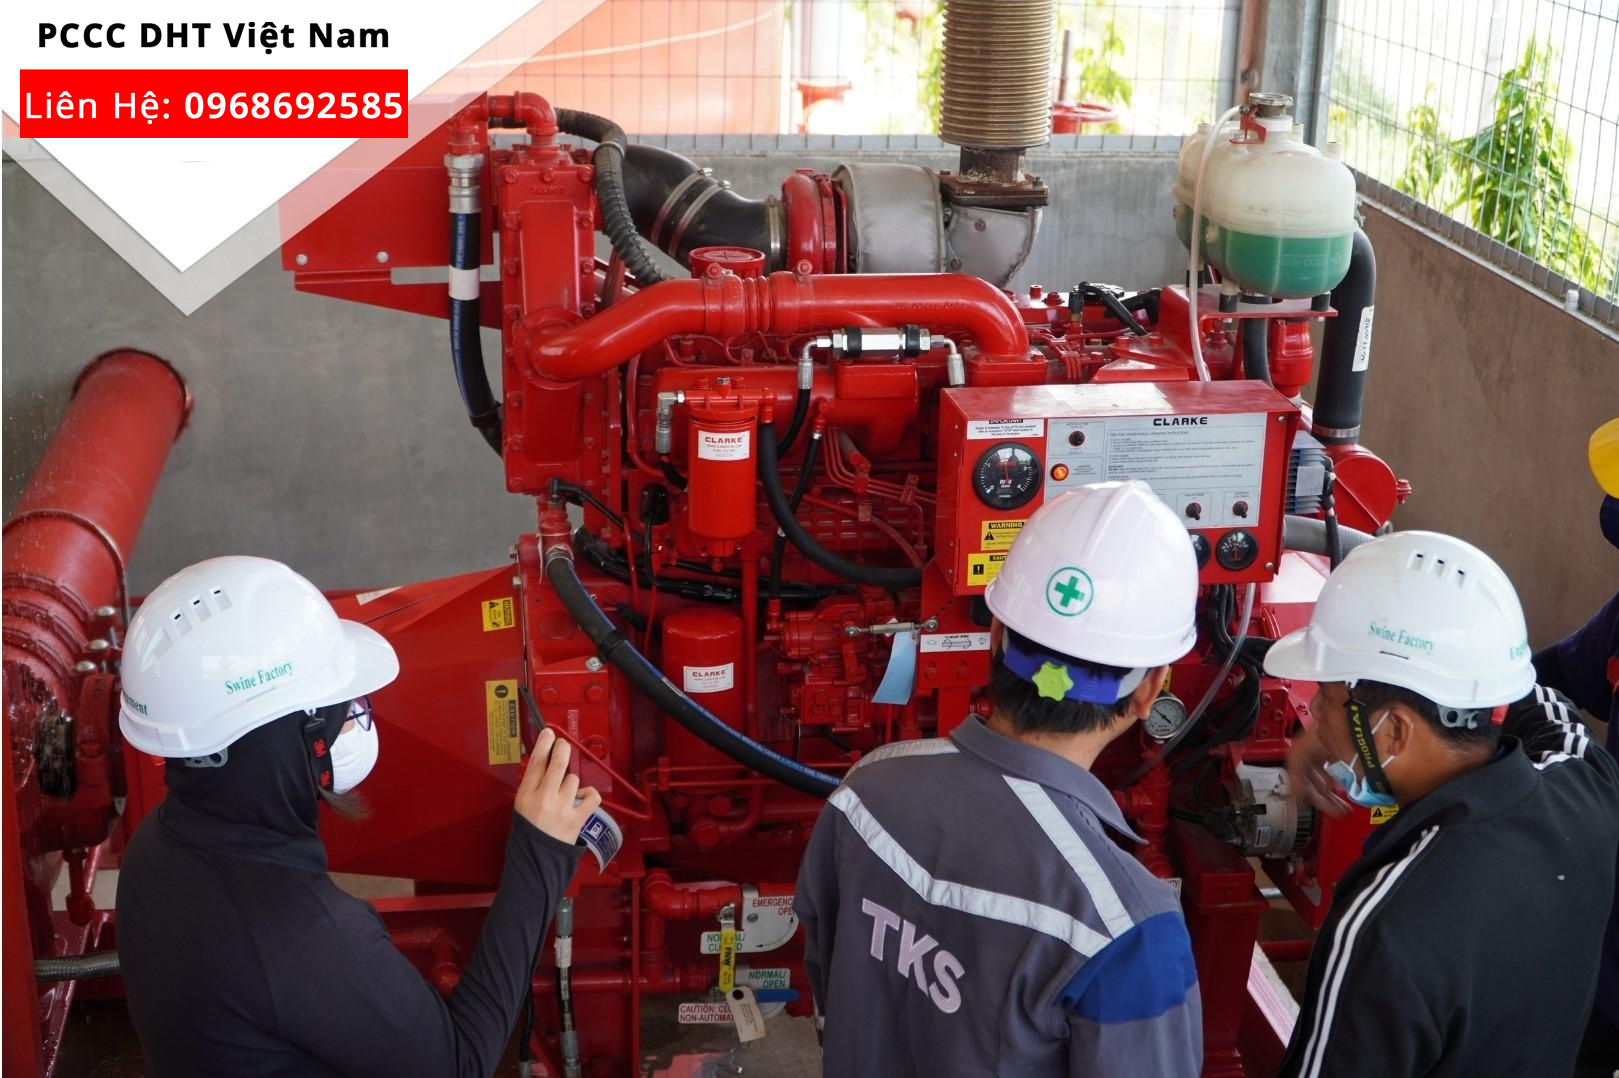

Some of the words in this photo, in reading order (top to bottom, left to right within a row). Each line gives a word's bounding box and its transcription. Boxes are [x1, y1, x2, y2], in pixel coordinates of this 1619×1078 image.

[1153, 416, 1208, 427] CLARKE
[1369, 621, 1396, 641] Swine
[1398, 629, 1433, 655] Factory
[225, 676, 257, 694] Swine
[257, 661, 292, 684] Factory
[692, 669, 726, 678] CLARKE
[862, 898, 965, 1014] TKS
[748, 970, 787, 980] NORMAL/
[763, 980, 785, 988] OPEN
[680, 1005, 716, 1014] CAUTION:
